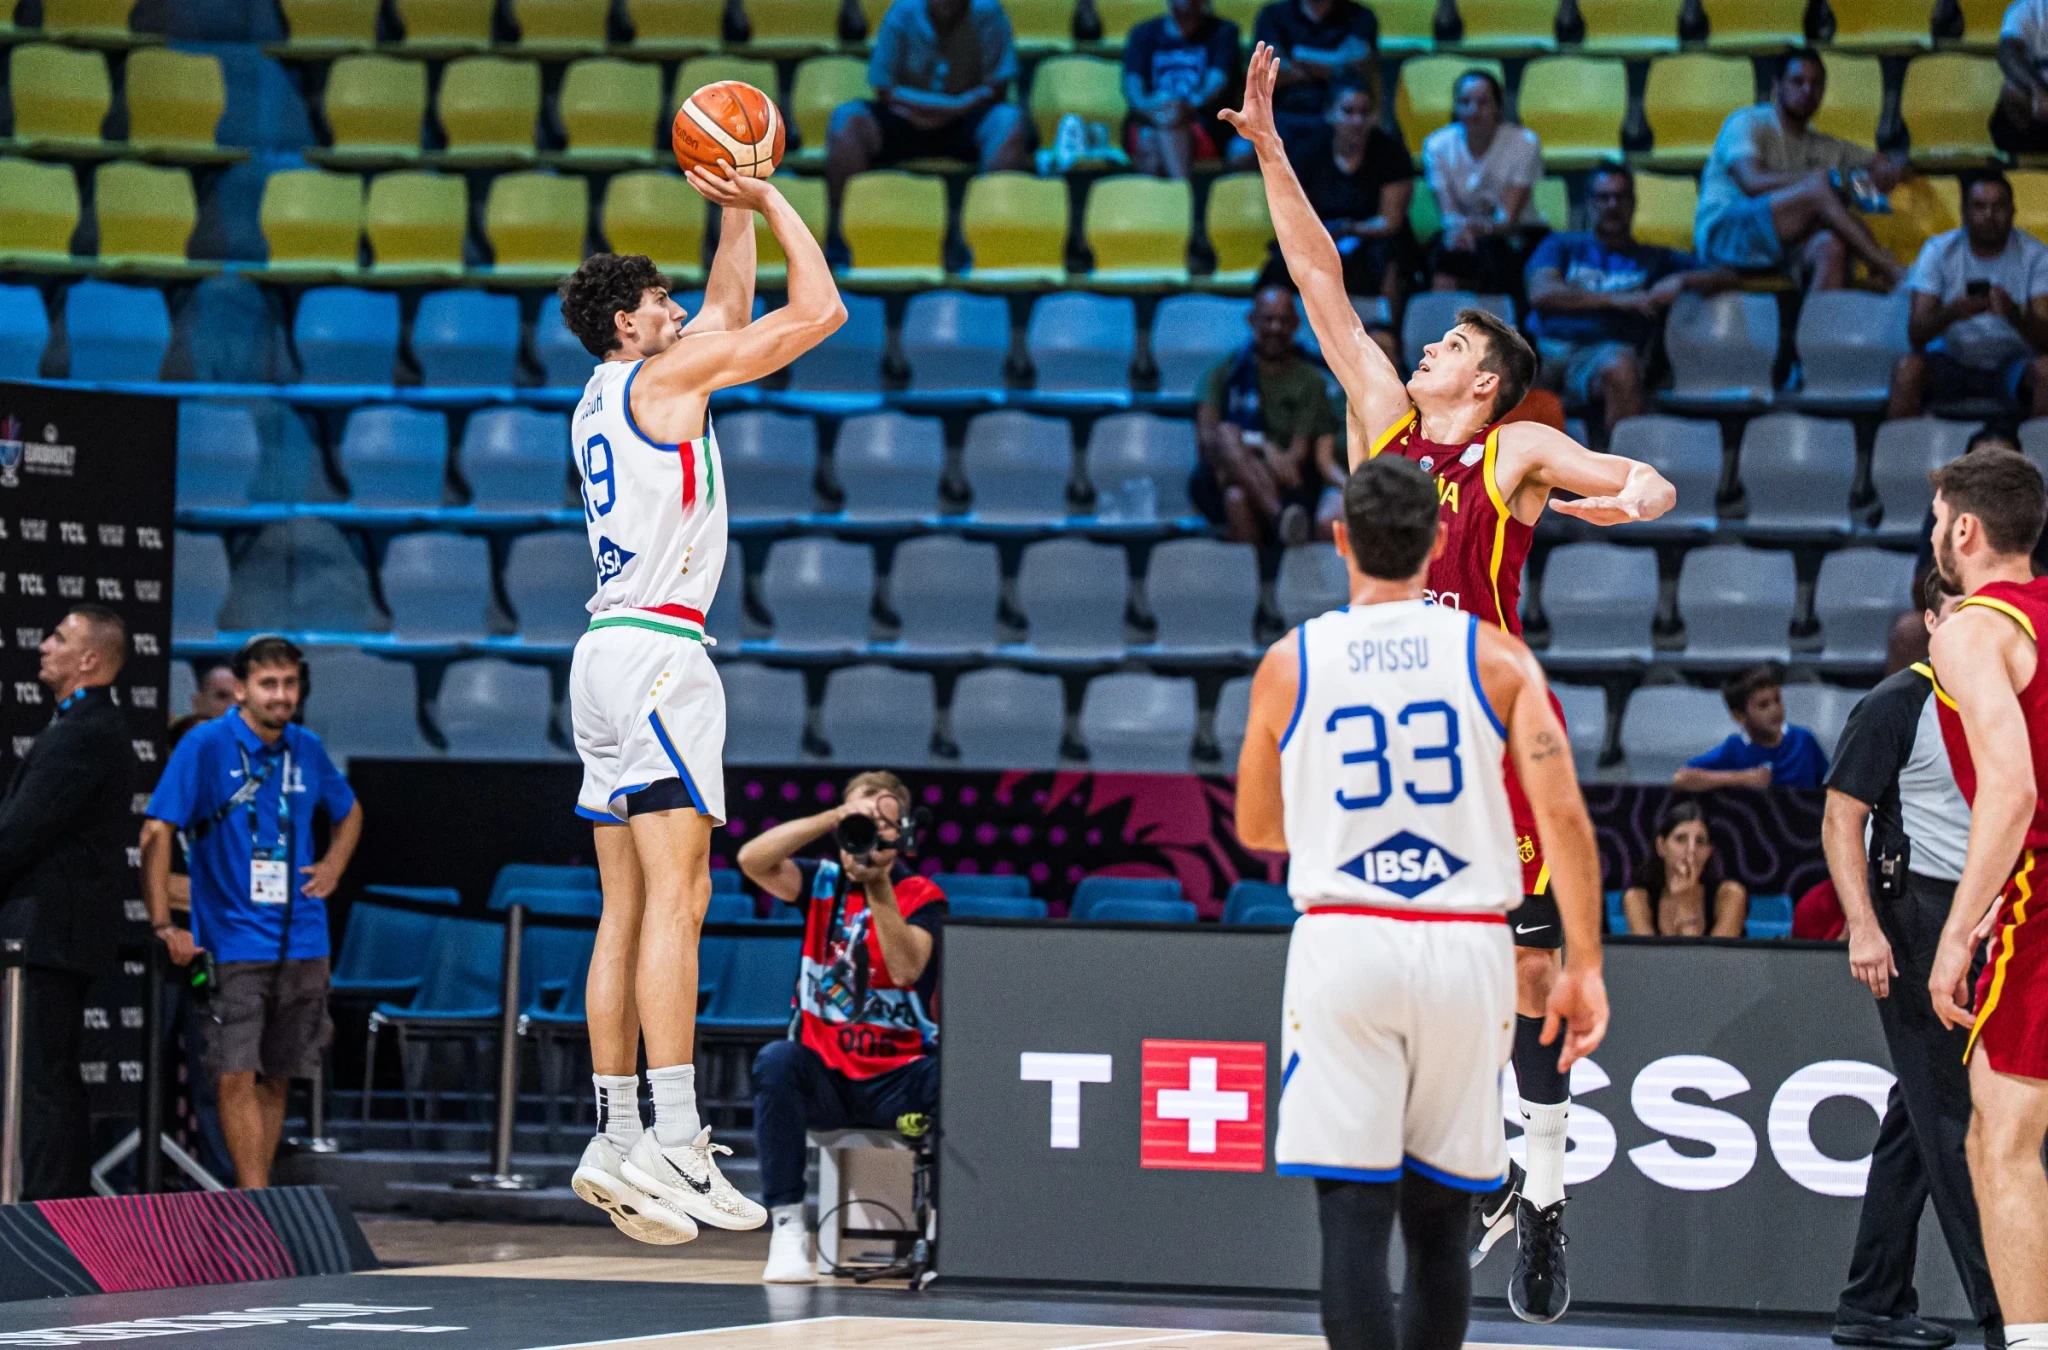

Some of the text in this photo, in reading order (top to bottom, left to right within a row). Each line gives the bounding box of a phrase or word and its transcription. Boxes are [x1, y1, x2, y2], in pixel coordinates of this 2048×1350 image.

[581, 432, 616, 523] 19
[59, 521, 88, 545] TCL
[136, 526, 164, 550] TCL
[598, 548, 622, 577] BSA
[18, 572, 47, 596] TCL
[96, 577, 124, 601] TCL
[132, 632, 160, 656] TCL
[1347, 636, 1430, 674] SPISSU
[14, 681, 43, 705] TCL
[1325, 699, 1464, 811] 33
[1363, 848, 1451, 884] IBSA
